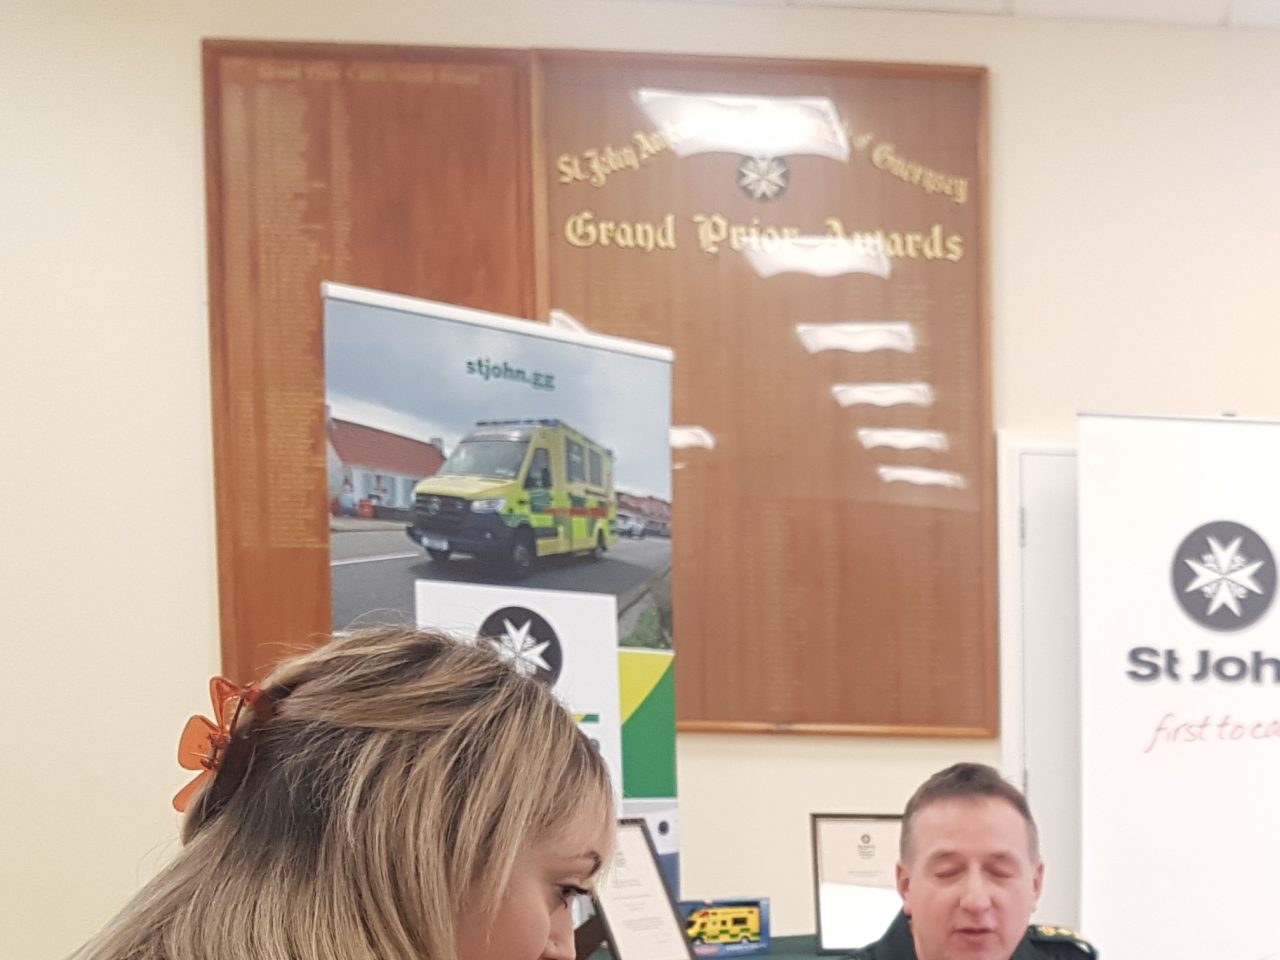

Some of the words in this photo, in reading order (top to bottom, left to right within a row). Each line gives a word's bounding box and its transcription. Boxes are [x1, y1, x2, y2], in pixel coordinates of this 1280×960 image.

[871, 144, 968, 204] Guernsey
[564, 211, 677, 251] Grand
[465, 358, 556, 392] stjohn.gg
[1127, 646, 1180, 682] St
[1143, 713, 1211, 754] first
[1216, 714, 1245, 741] to
